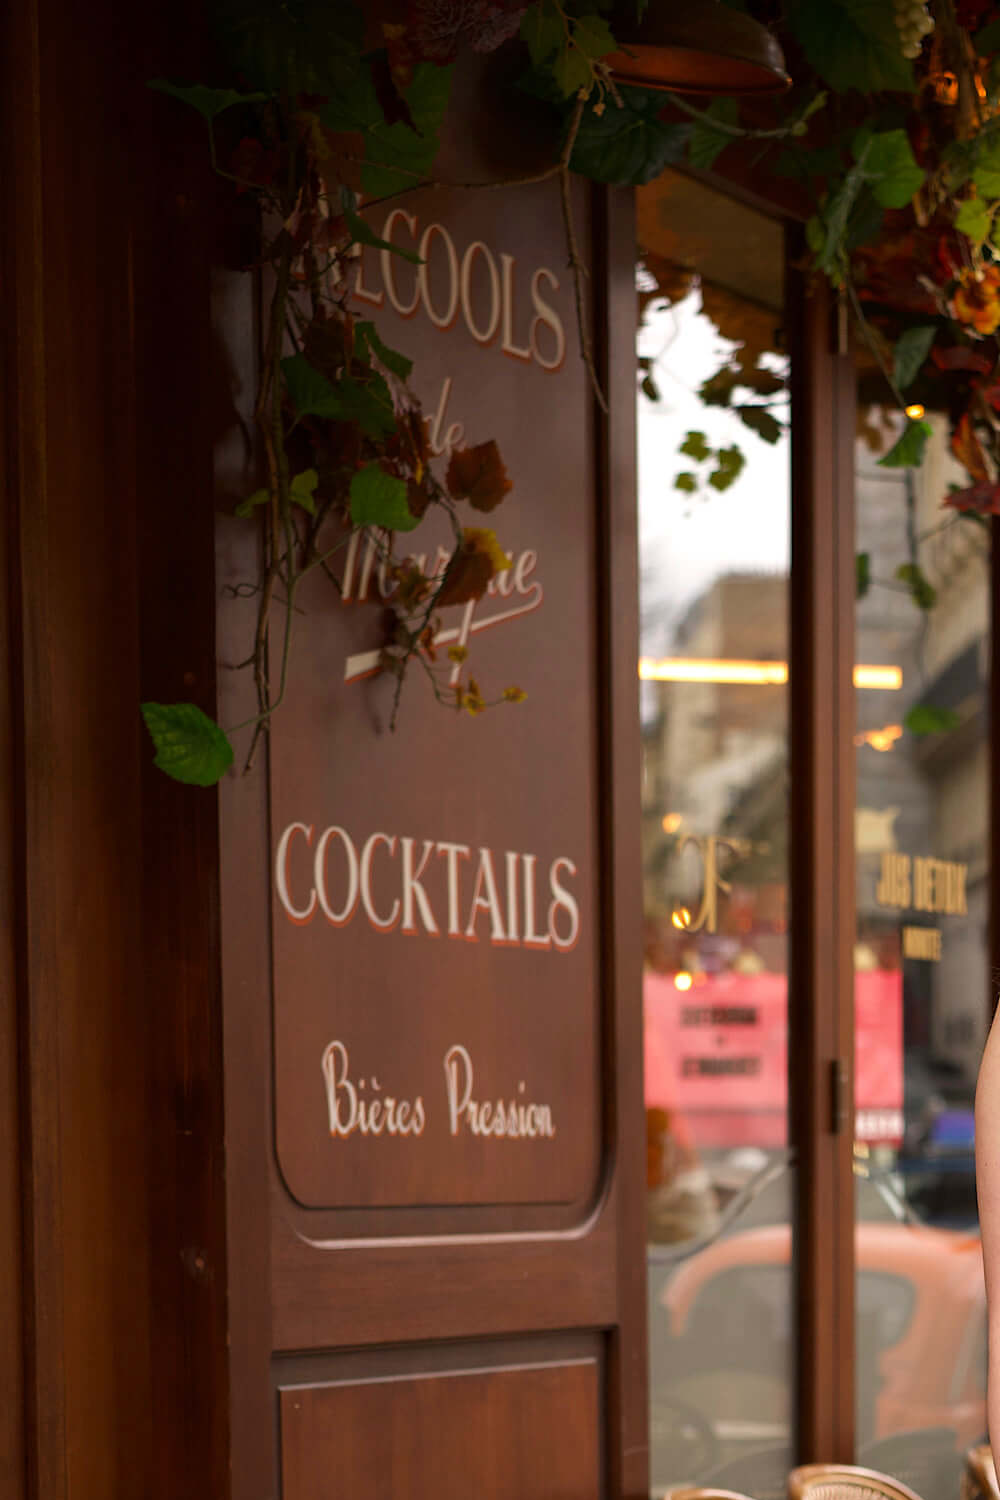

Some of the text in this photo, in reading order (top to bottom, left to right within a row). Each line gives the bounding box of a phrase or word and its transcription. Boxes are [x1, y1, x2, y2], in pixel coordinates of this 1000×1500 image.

[292, 177, 566, 372] LCOOLS
[275, 821, 580, 952] COCKTAILS
[321, 1039, 556, 1138] Bières Pression
